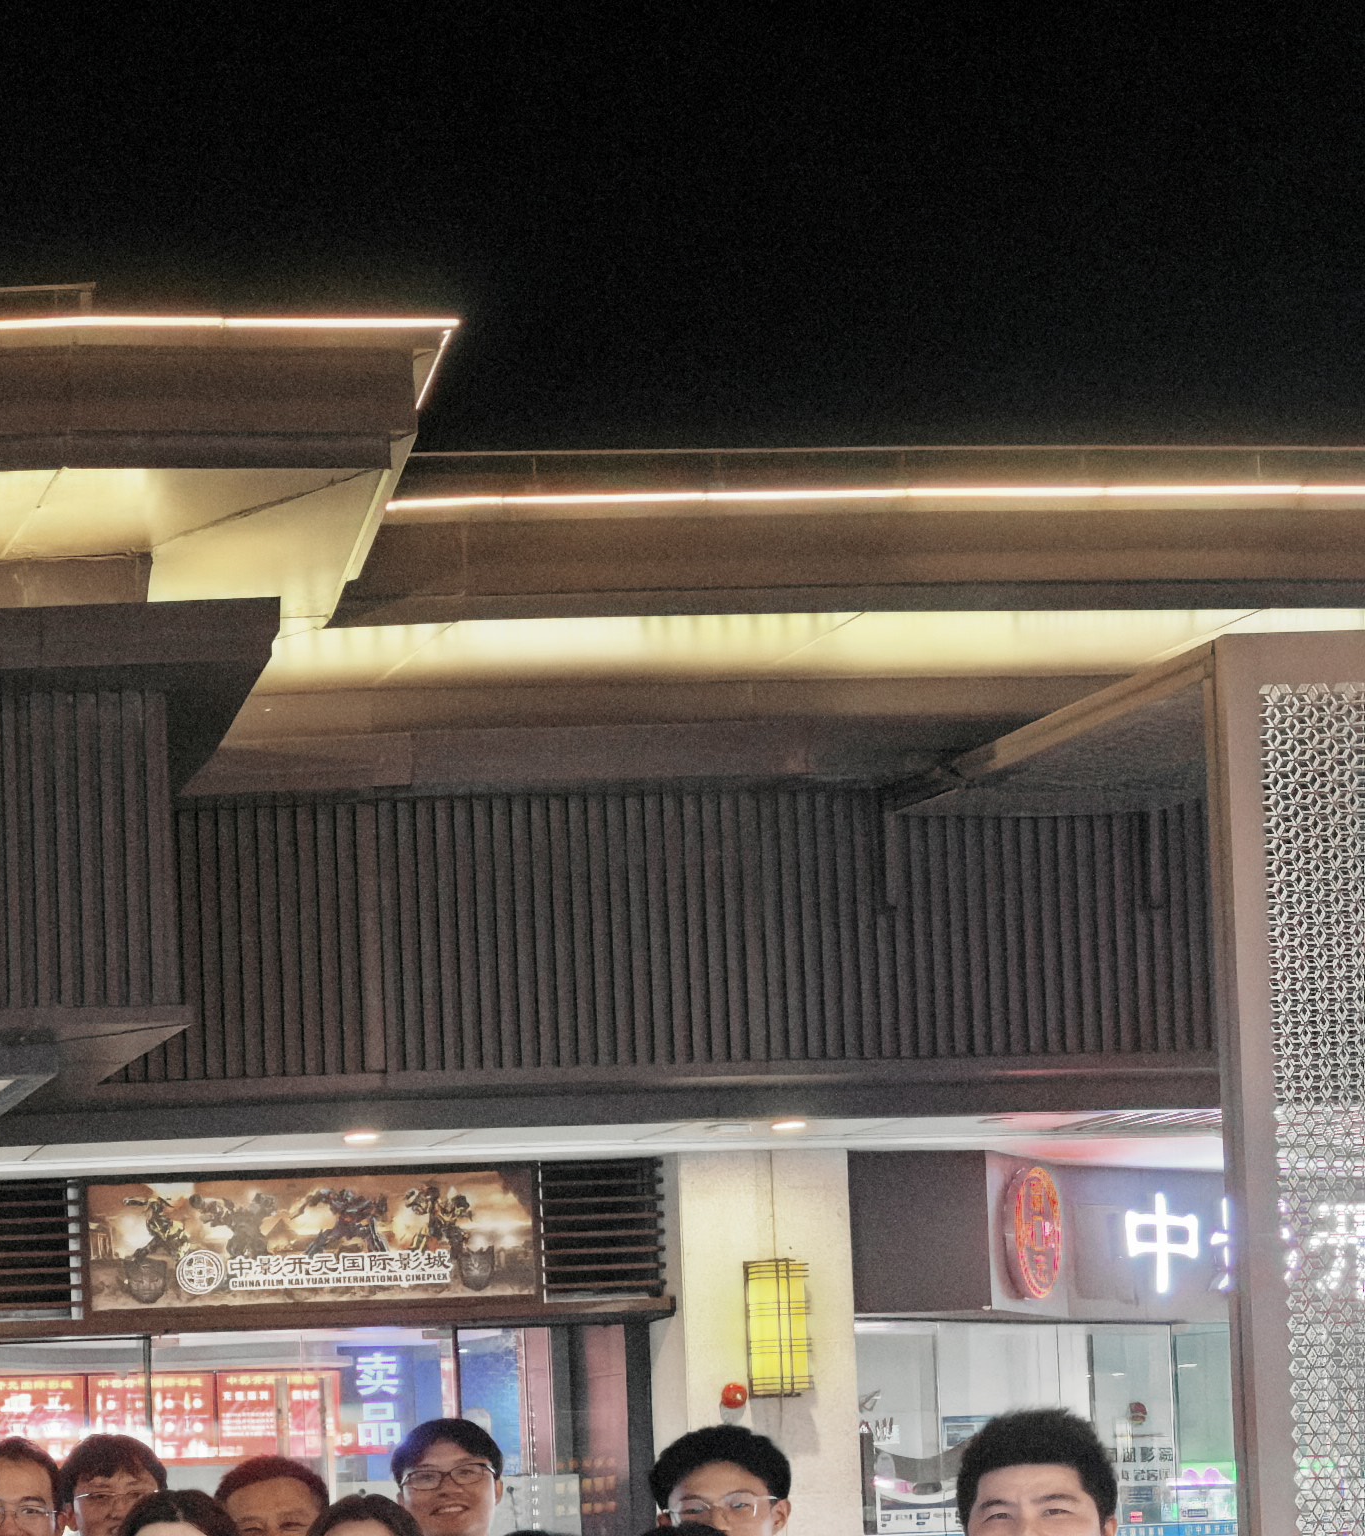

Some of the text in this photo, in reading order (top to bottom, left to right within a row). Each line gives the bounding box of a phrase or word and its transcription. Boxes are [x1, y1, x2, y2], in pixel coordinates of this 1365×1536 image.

[230, 1250, 450, 1277] 中影开元国际影城
[231, 1272, 448, 1288] CHINA FILM KAI YUAN INTERNATIONAL CINEPLEX
[356, 1353, 401, 1447] 卖品
